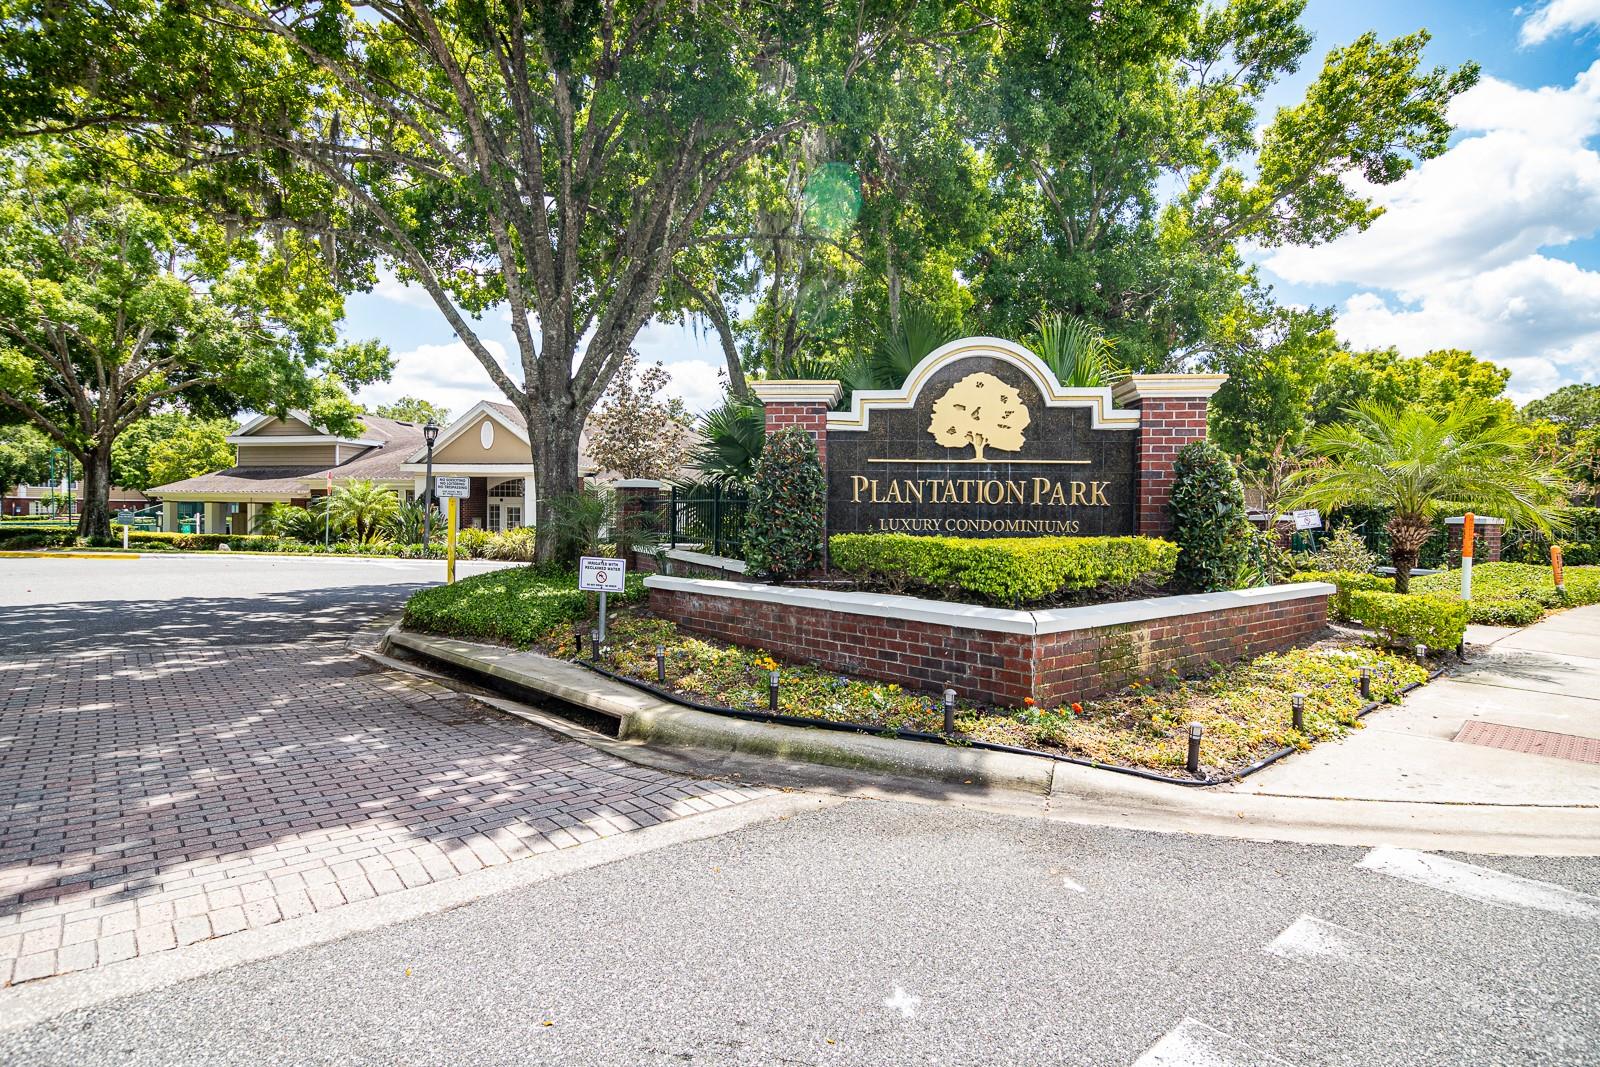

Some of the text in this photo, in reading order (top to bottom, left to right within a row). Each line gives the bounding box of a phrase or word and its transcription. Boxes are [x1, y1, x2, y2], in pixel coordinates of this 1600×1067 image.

[850, 475, 1111, 507] PLANTATION PARK
[879, 518, 1080, 534] LUXURY CONDOMINIUMS
